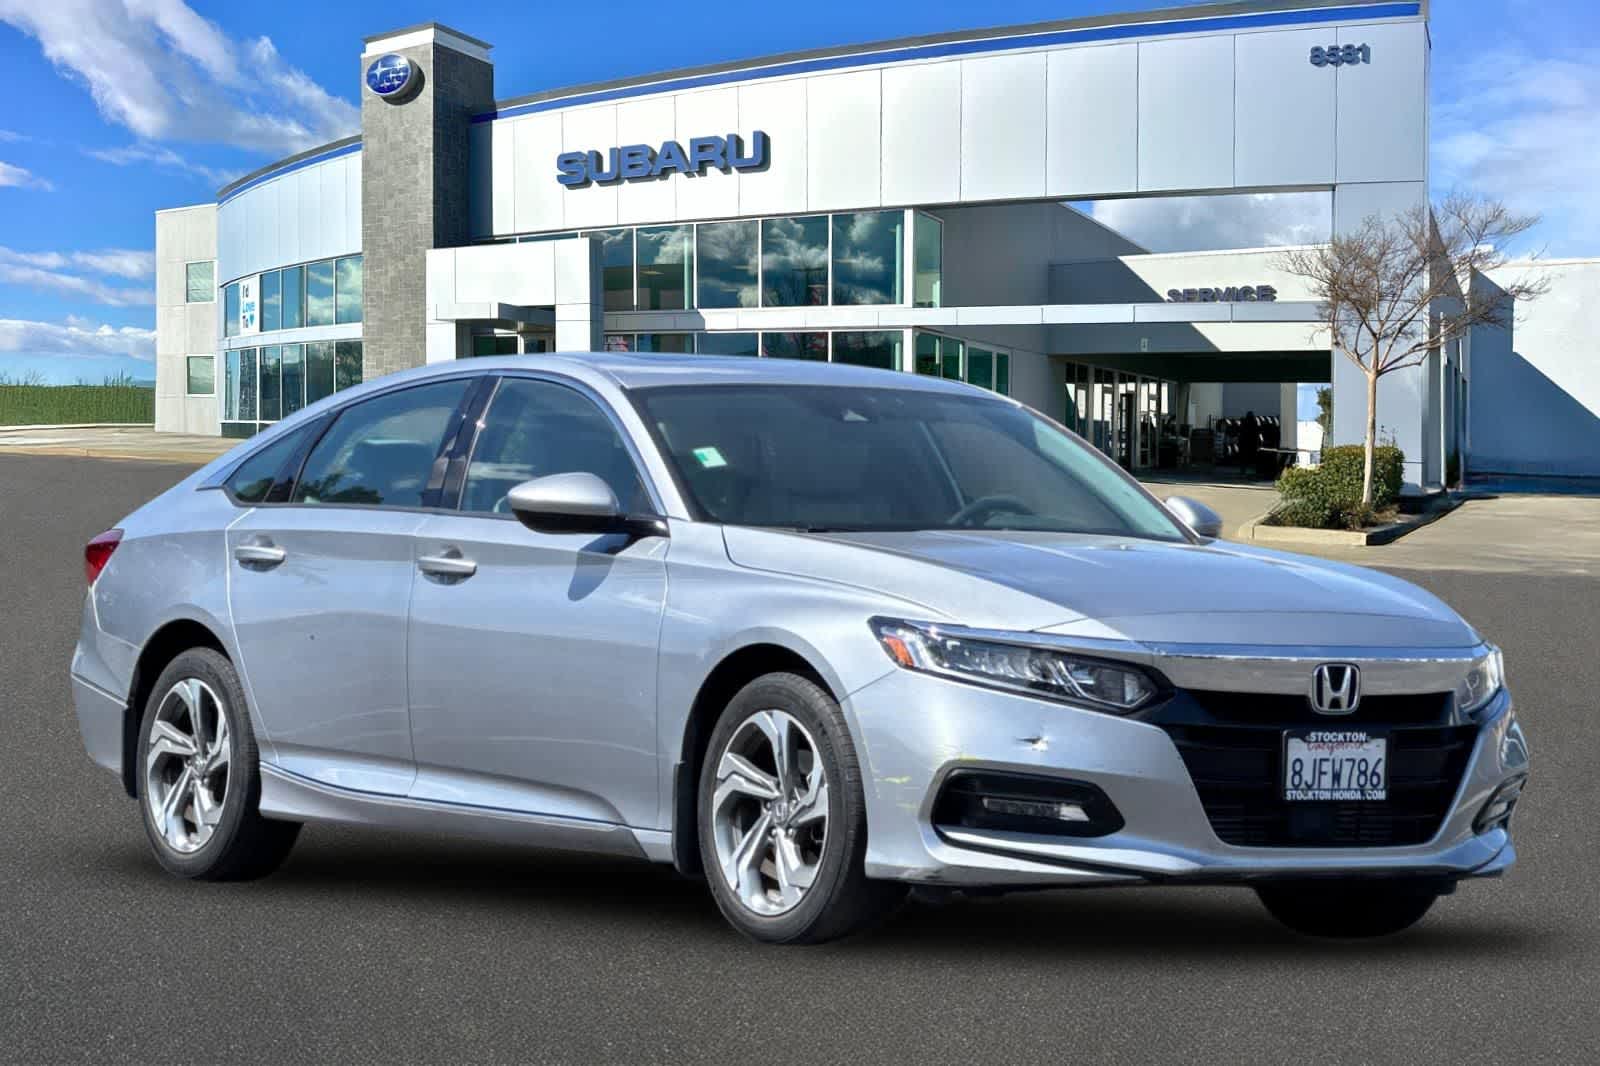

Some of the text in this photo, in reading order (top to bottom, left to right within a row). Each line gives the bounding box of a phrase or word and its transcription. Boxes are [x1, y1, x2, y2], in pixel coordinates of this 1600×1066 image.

[556, 130, 771, 190] SUBARU
[1166, 285, 1278, 302] SERVICE
[1309, 732, 1367, 743] STOCKTON
[1291, 758, 1382, 789] 8JFW786
